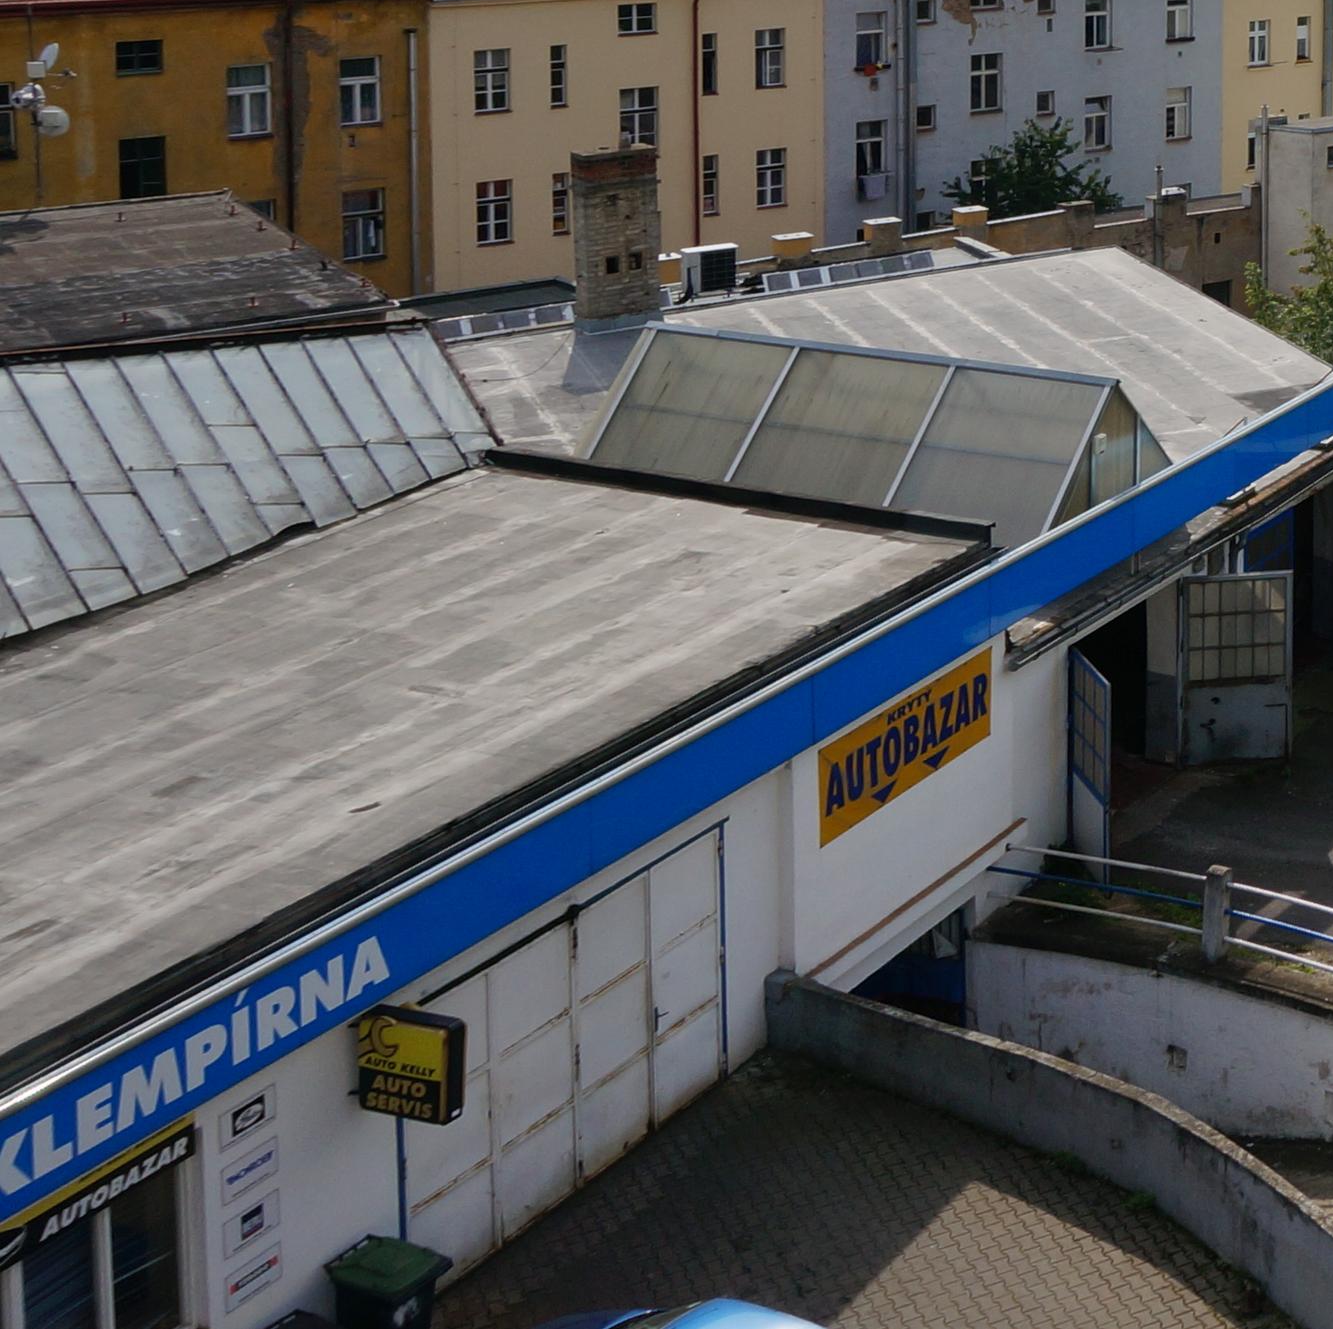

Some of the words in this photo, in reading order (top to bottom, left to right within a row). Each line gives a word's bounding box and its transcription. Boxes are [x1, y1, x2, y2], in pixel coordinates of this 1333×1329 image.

[825, 673, 988, 818] AUTOBAZAR
[0, 936, 391, 1196] KLEMPÍRNA
[365, 1056, 397, 1070] AUTO
[400, 1063, 436, 1078] KELLY
[371, 1074, 426, 1098] AUTO
[366, 1092, 433, 1118] SERVIS
[39, 1136, 189, 1243] AUTOBAZAR
